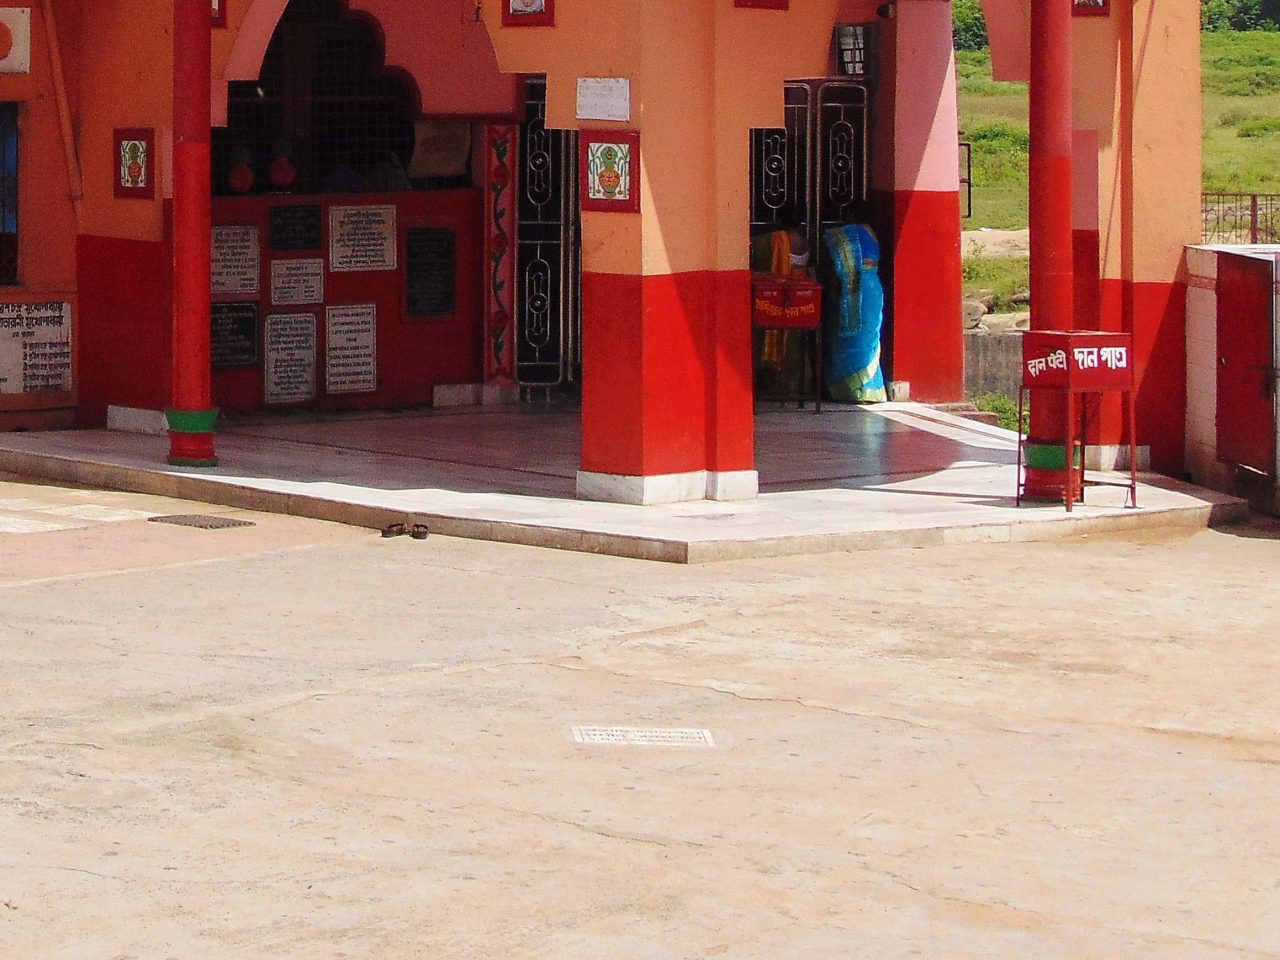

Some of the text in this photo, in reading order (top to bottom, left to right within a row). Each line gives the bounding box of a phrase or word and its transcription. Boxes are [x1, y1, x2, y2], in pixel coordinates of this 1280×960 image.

[1027, 349, 1067, 378] दान पेटी
[1073, 347, 1127, 370] দান পাত্র
